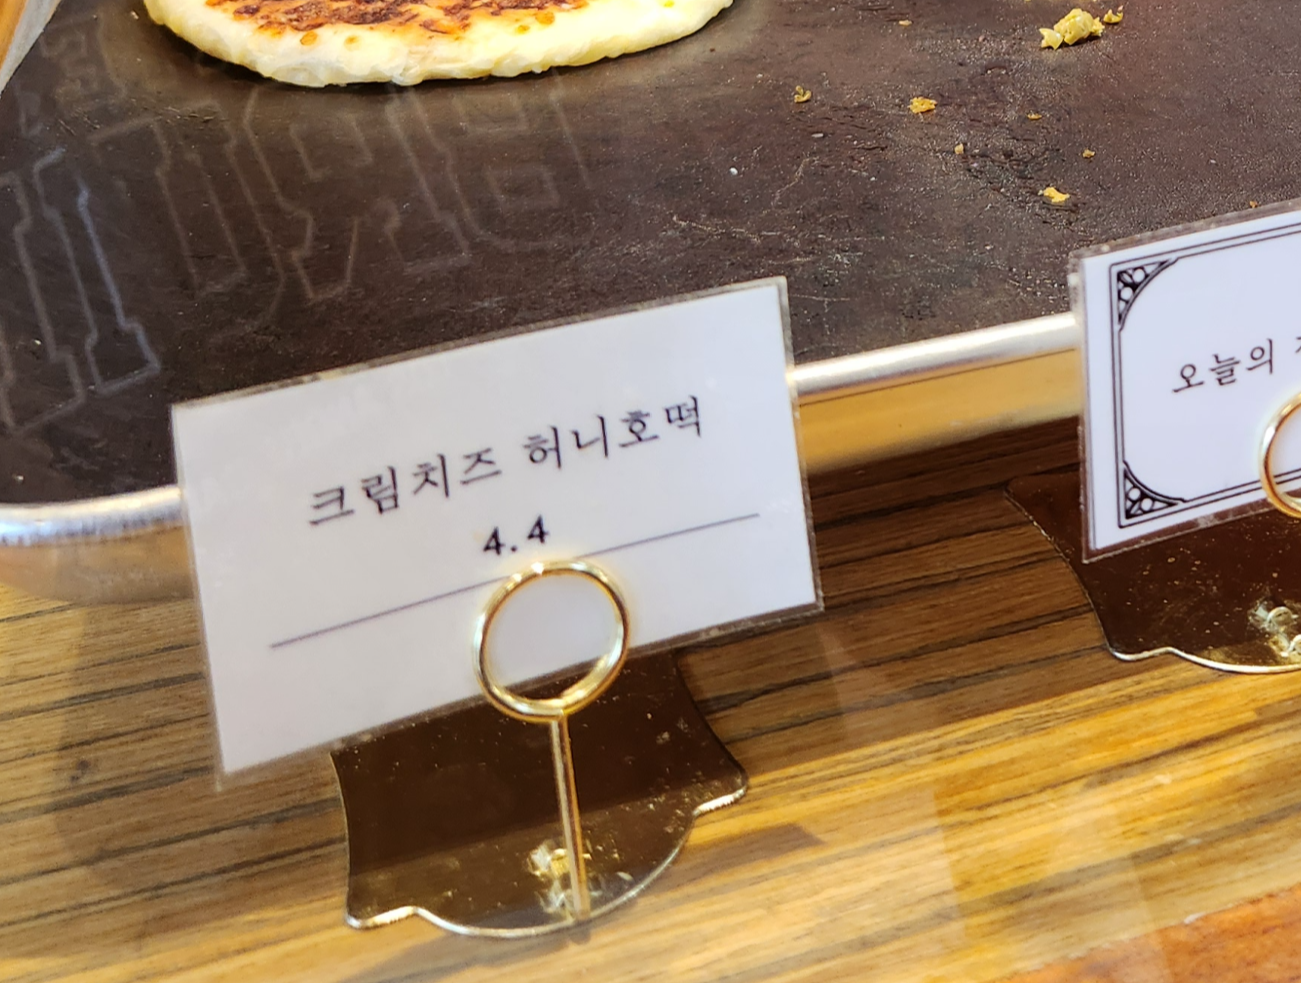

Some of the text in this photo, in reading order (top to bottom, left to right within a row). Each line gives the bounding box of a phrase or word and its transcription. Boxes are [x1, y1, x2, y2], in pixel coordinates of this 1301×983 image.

[1171, 337, 1275, 394] 오늘의
[307, 395, 702, 527] 크림치즈 허니호떡
[481, 514, 550, 557] 4.4
